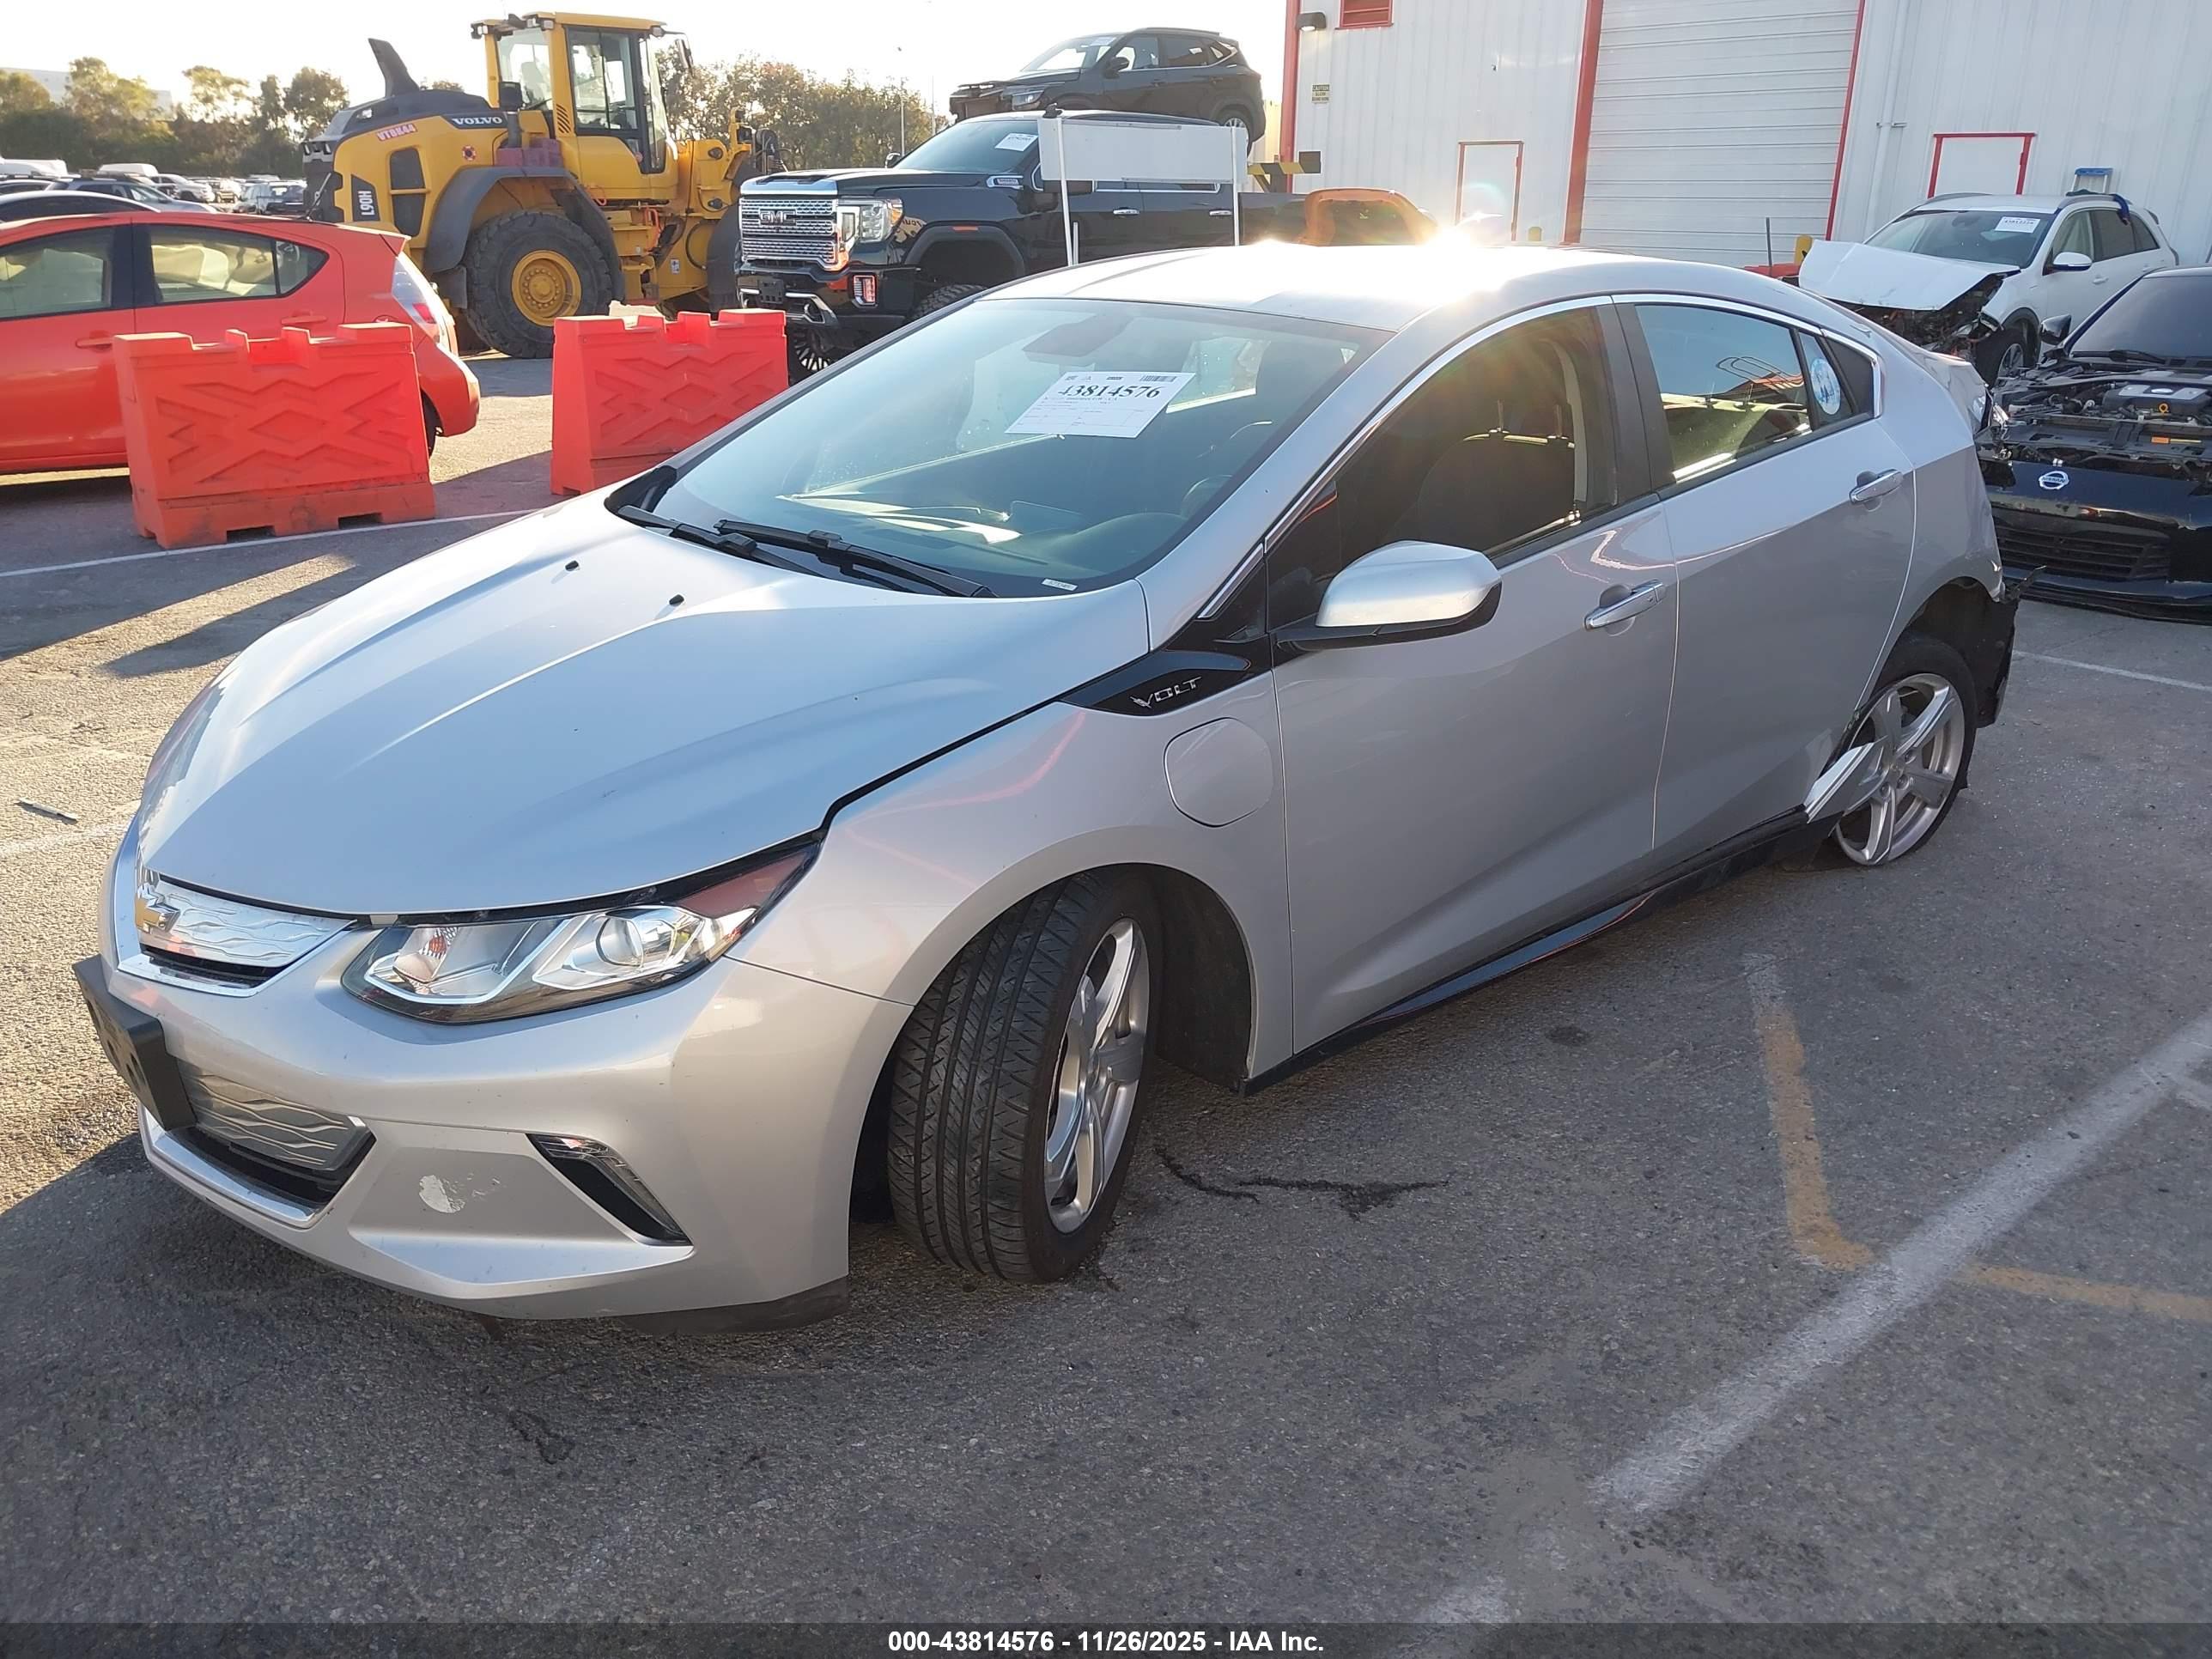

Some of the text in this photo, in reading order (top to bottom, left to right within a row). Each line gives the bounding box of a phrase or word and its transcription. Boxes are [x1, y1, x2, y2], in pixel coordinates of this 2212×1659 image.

[452, 117, 503, 125] VOLVO
[357, 190, 375, 216] L90H
[759, 210, 797, 224] GMC
[1058, 385, 1165, 398] 43814576
[1129, 676, 1202, 708] VOLT
